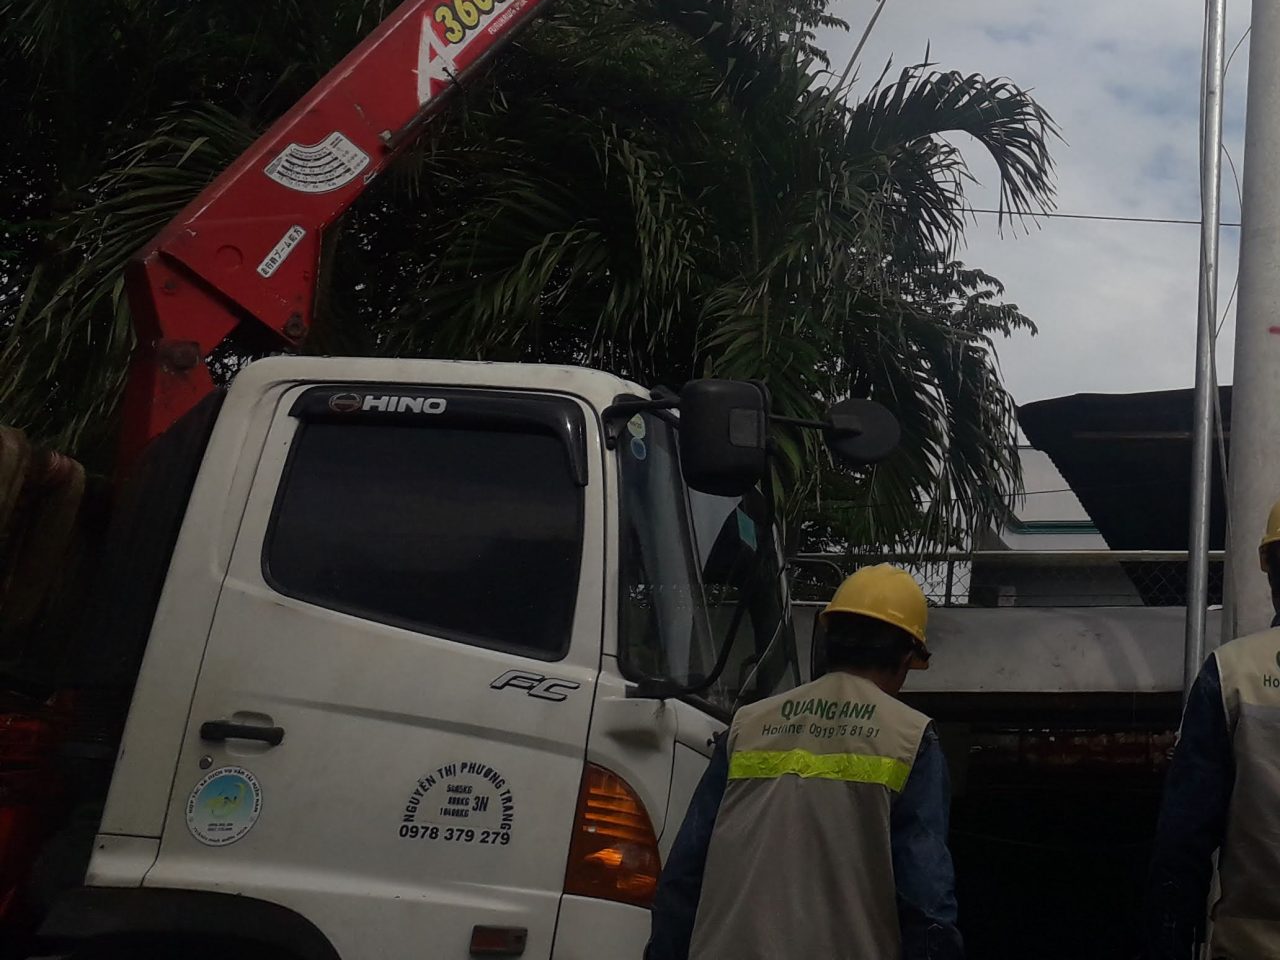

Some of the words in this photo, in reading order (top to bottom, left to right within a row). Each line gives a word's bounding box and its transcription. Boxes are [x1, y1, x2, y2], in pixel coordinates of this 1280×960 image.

[361, 394, 447, 415] HINO
[489, 669, 580, 701] FC
[781, 698, 838, 721] QUANG
[839, 701, 877, 721] ANH
[850, 724, 863, 737] 81
[866, 726, 880, 739] 91
[437, 764, 457, 779] THỊ
[499, 788, 514, 831] TRANG
[472, 796, 490, 812] 3N
[399, 825, 439, 840] 0978
[444, 828, 475, 842] 379
[480, 830, 510, 846] 279
